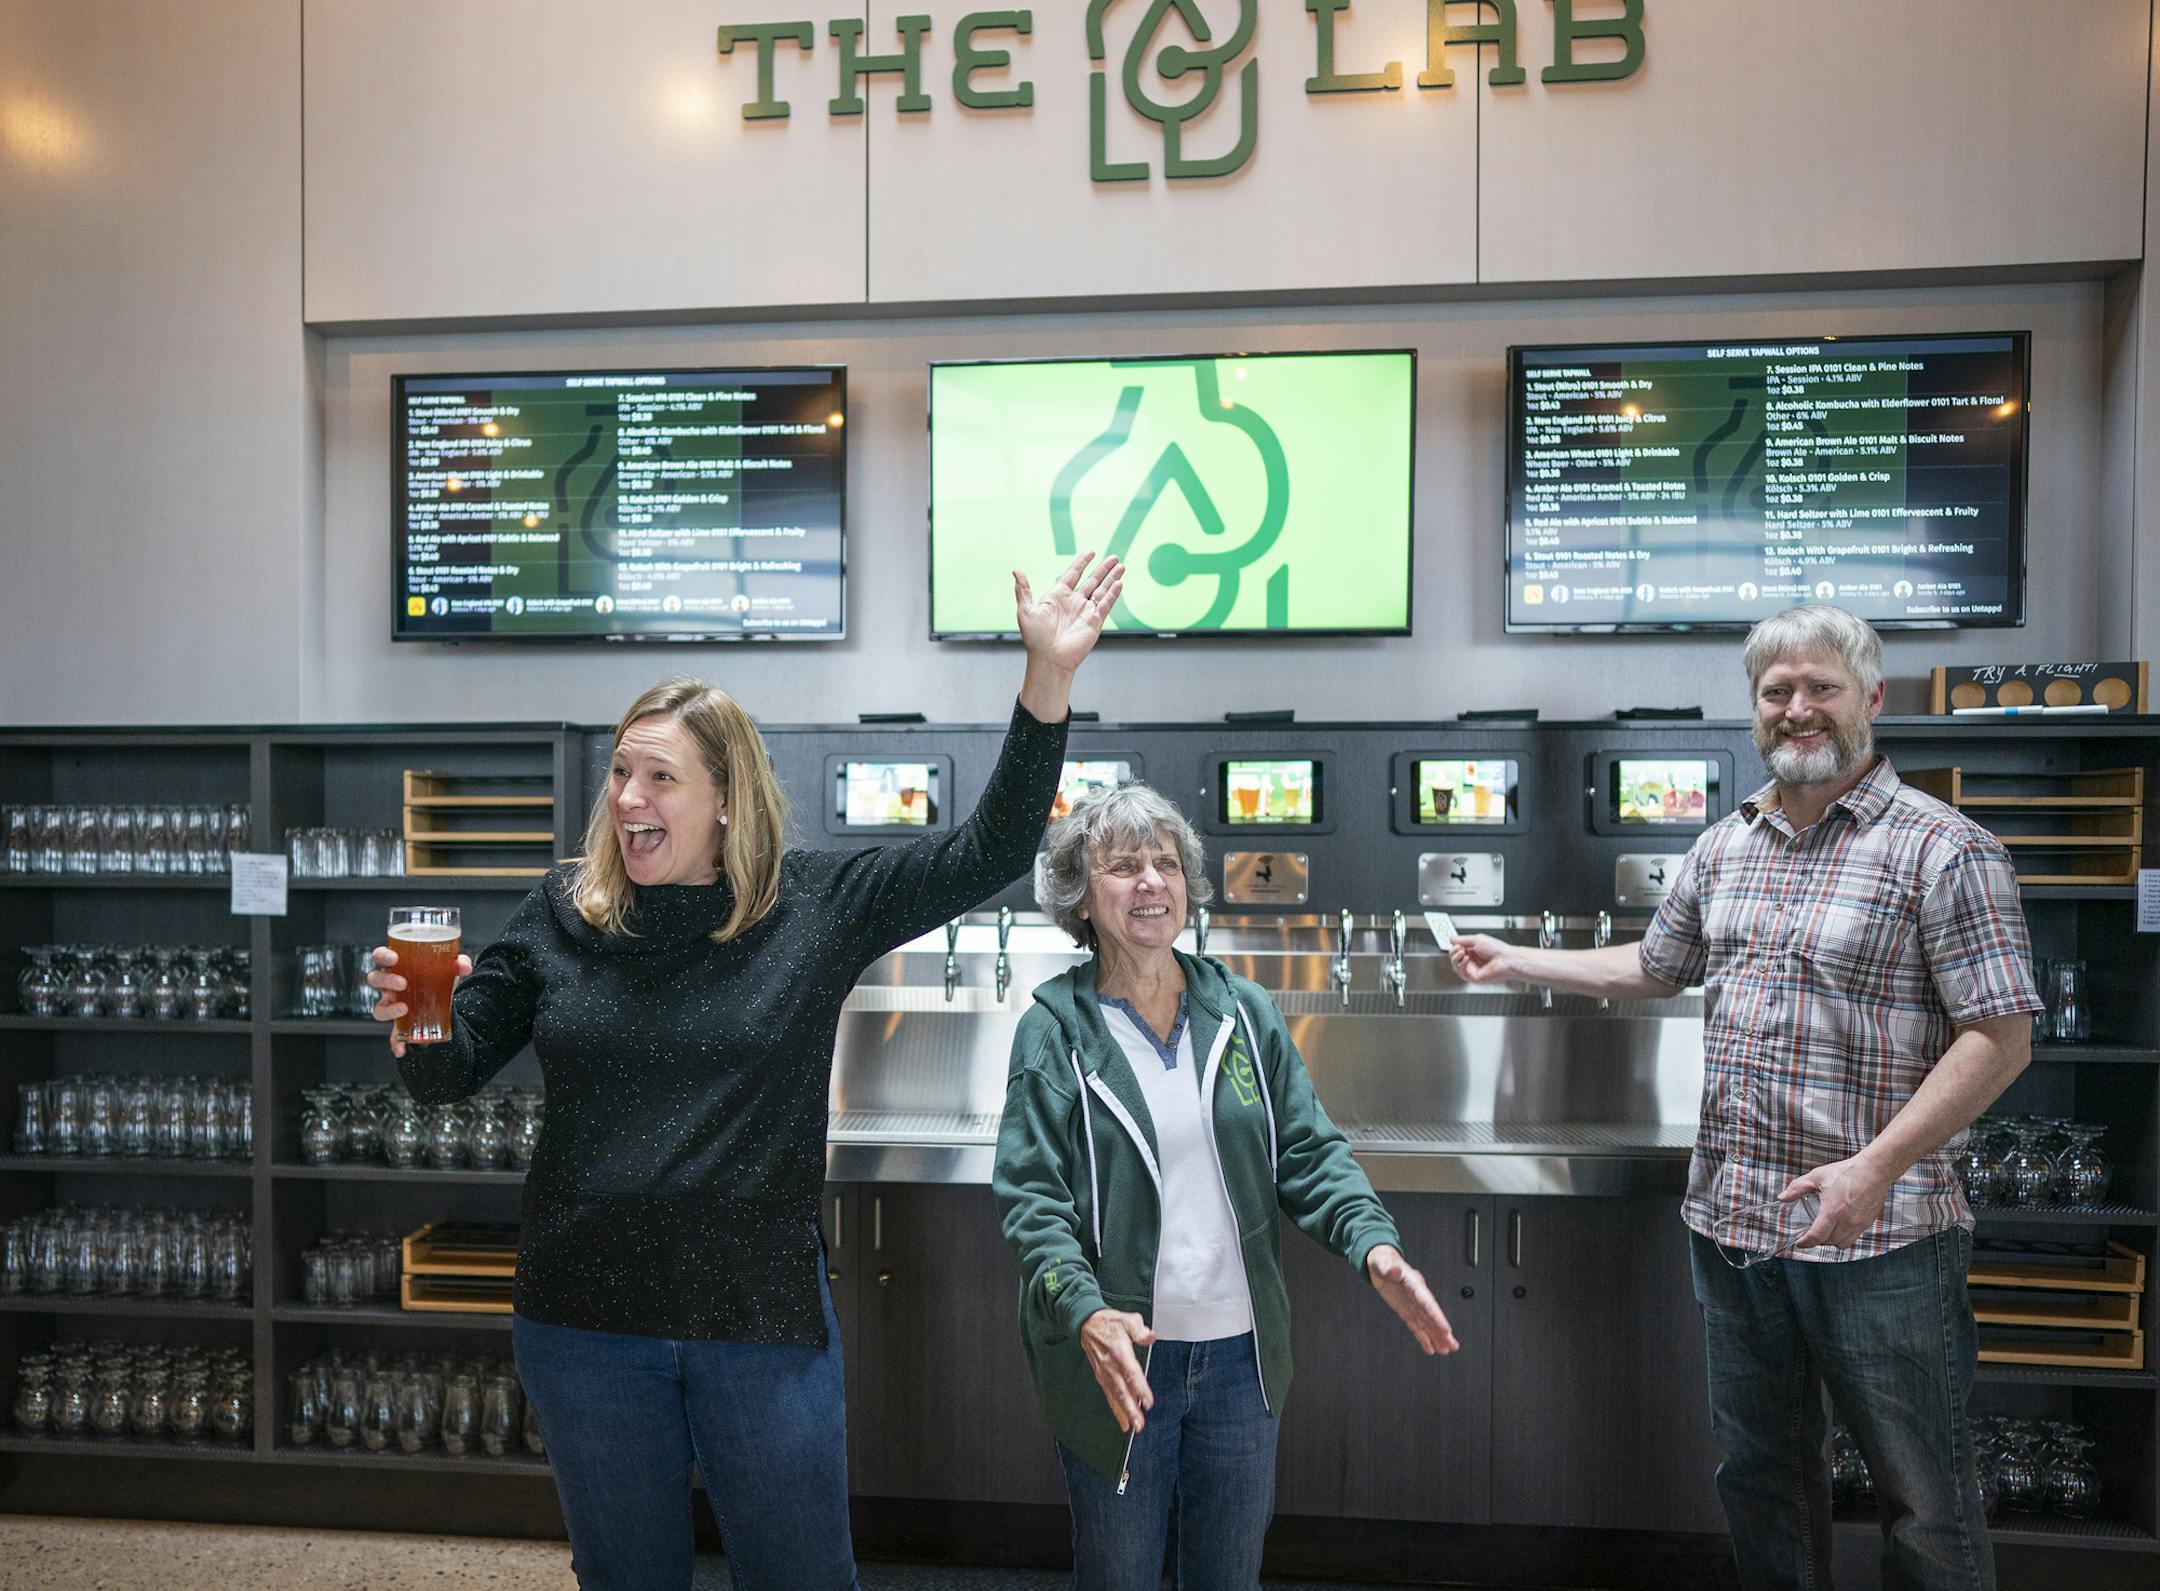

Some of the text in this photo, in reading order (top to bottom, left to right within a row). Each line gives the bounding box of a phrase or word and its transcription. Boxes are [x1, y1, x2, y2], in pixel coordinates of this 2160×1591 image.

[717, 0, 1648, 120] THE LAB
[1774, 365, 1807, 374] Session
[1808, 364, 1822, 373] IPA
[1823, 364, 1842, 373] 0101
[1843, 363, 1867, 373] Clean
[1868, 363, 1876, 372] &
[1877, 363, 1897, 372] Pine
[1898, 362, 1924, 371] Notes
[1766, 374, 1862, 384] IPA Session 4.1% ABV
[1766, 386, 1780, 395] 1oz
[1775, 401, 1813, 411] Alcoholic
[1815, 400, 1859, 410] Kombucha
[1860, 399, 1880, 408] with
[1881, 398, 1929, 408] Elderflower
[1930, 397, 1950, 406] 0101
[1951, 397, 1969, 406] Tart
[1970, 396, 1978, 405] &
[1979, 396, 2004, 405] Floral
[1766, 411, 1828, 421] Other 6% ABV
[1766, 422, 1779, 431] 1oz
[1774, 437, 1814, 447] American
[1815, 437, 1842, 446] Brown
[1843, 436, 1857, 445] Ale
[1858, 436, 1877, 445] 0101
[1878, 435, 1898, 444] Malt
[1899, 435, 1907, 444] &
[1908, 434, 1937, 444] Biscuit
[1938, 434, 1965, 443] Notes
[1765, 446, 1897, 457] Brown Ale American 5.1% ABV
[1765, 459, 1779, 467] 1oz
[1778, 474, 1806, 483] Kolsch
[1807, 474, 1826, 483] 0101
[1827, 473, 1858, 482] Golden
[1859, 473, 1867, 482] &
[1868, 472, 1890, 483] Crisp
[1973, 664, 2098, 684] TRY A FLIGHT!
[432, 945, 452, 953] THE
